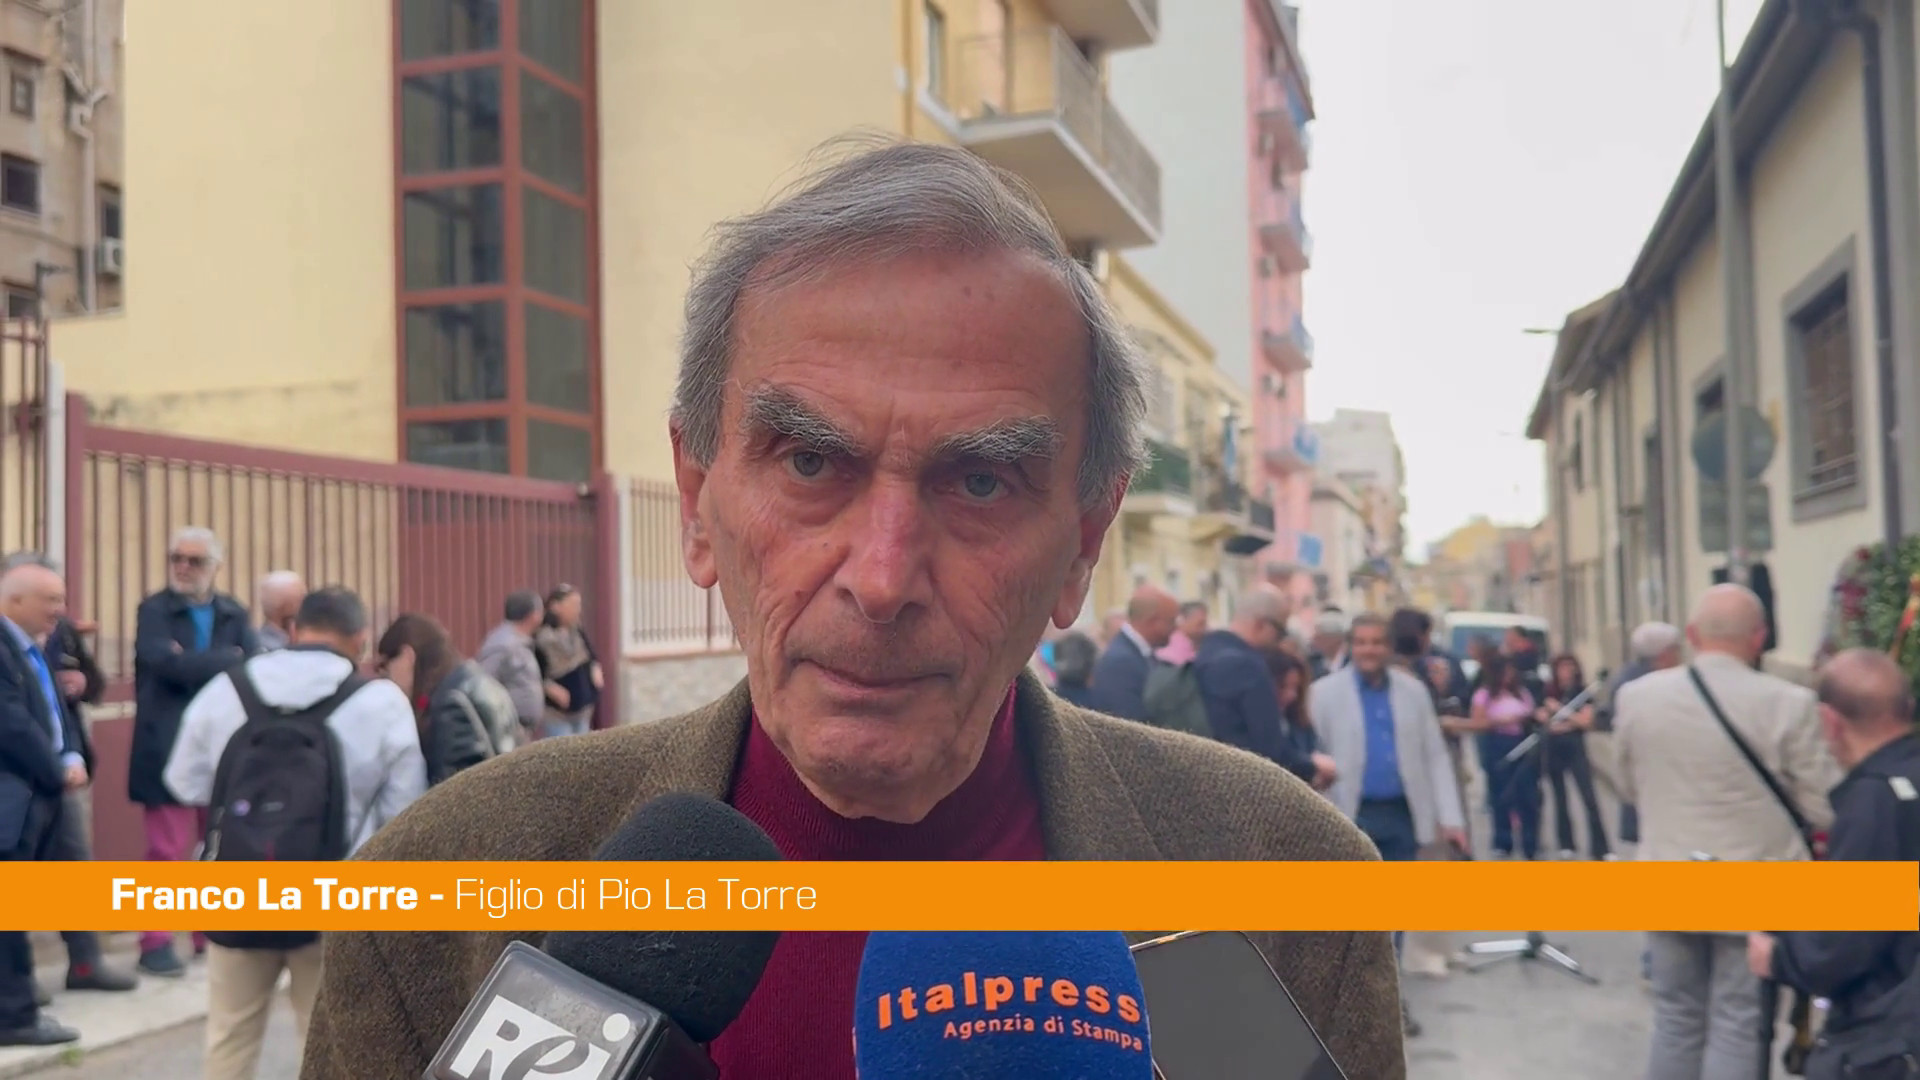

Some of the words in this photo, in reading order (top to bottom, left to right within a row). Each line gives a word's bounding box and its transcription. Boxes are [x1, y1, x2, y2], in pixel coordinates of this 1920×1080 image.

[878, 971, 1141, 1030] Italpress
[943, 1012, 1035, 1040] Agenzia
[1043, 1015, 1065, 1034] di
[1071, 1018, 1143, 1051] Stampa
